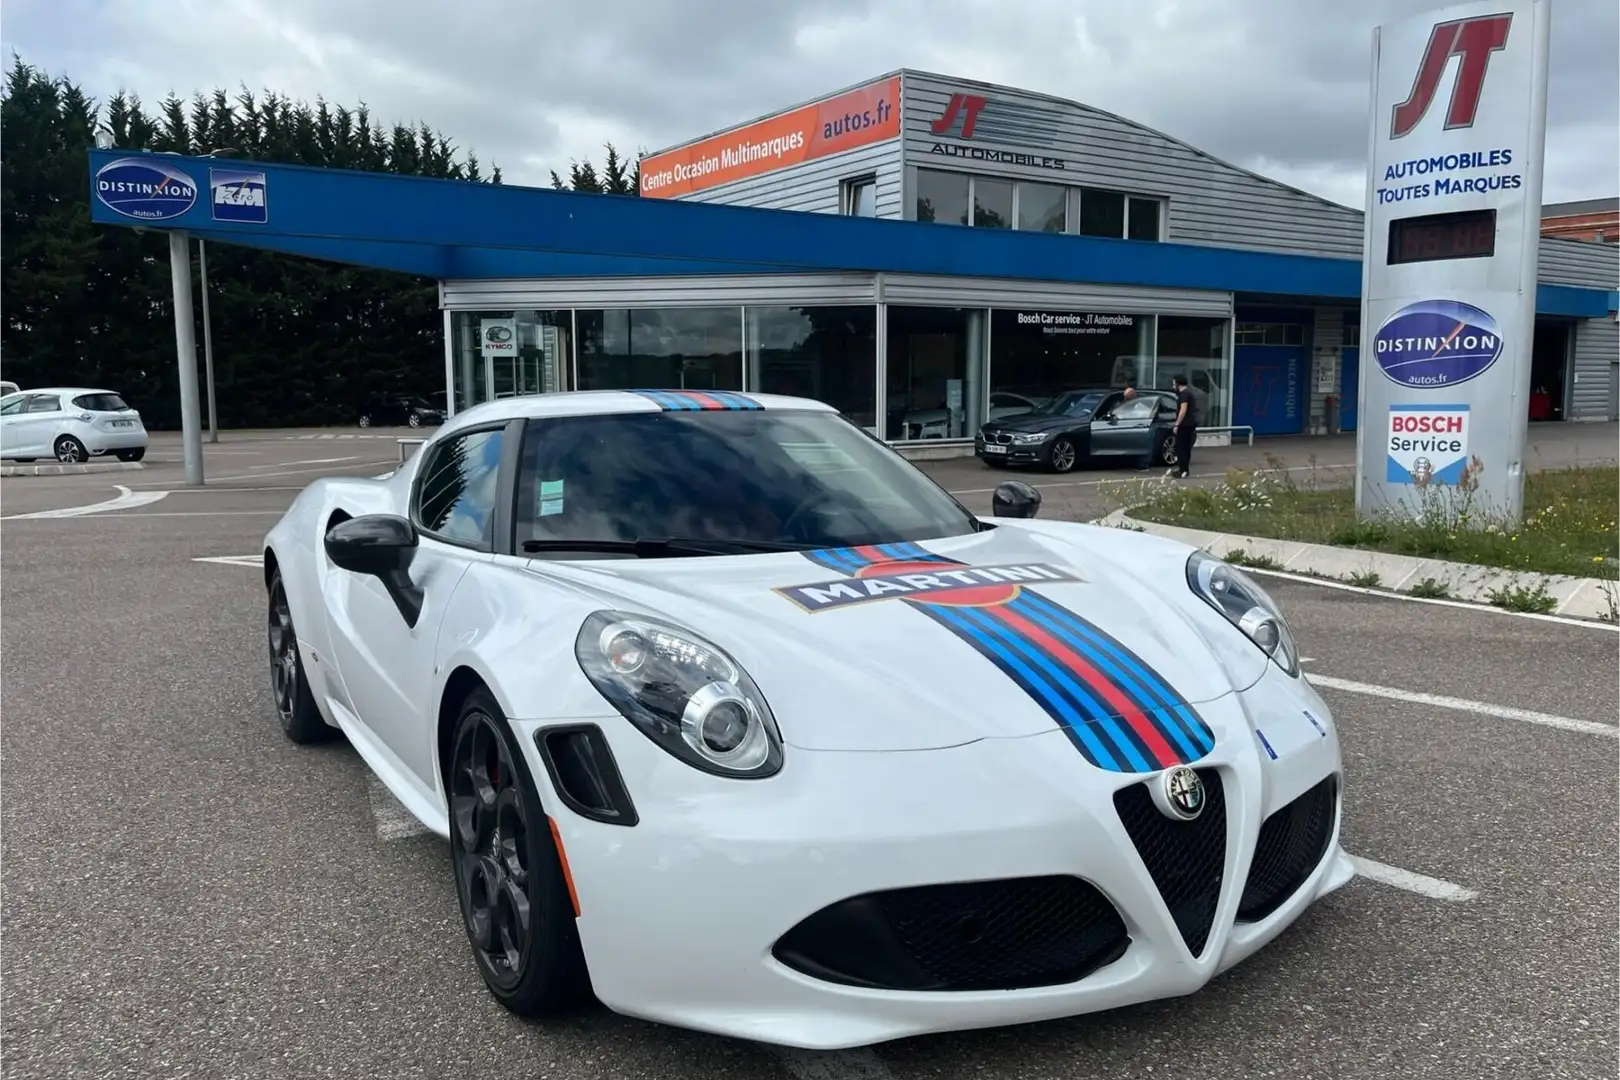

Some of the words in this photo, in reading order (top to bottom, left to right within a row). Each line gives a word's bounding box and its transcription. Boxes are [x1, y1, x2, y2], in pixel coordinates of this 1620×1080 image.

[1390, 12, 1514, 140] JT
[824, 99, 891, 139] autos.fr
[931, 92, 986, 140] JT
[643, 167, 672, 191] Centre
[674, 156, 719, 183] Occasion
[721, 131, 804, 169] Multimarques
[931, 143, 1065, 169] AUTOMOBILES
[1384, 149, 1512, 181] AUTOMOBILES
[100, 181, 192, 197] DISTINXION
[133, 209, 162, 217] autos.fr
[1018, 313, 1040, 324] Bosch
[1041, 313, 1054, 324] Car
[1055, 314, 1080, 324] service
[1085, 314, 1093, 324] JT
[1094, 315, 1133, 325] Automobiles
[1378, 335, 1494, 352] DISTINXION
[1408, 373, 1447, 384] autos.fr
[1392, 416, 1462, 433] BOSCH
[1390, 436, 1461, 452] Service
[799, 565, 1061, 604] MARTINI
